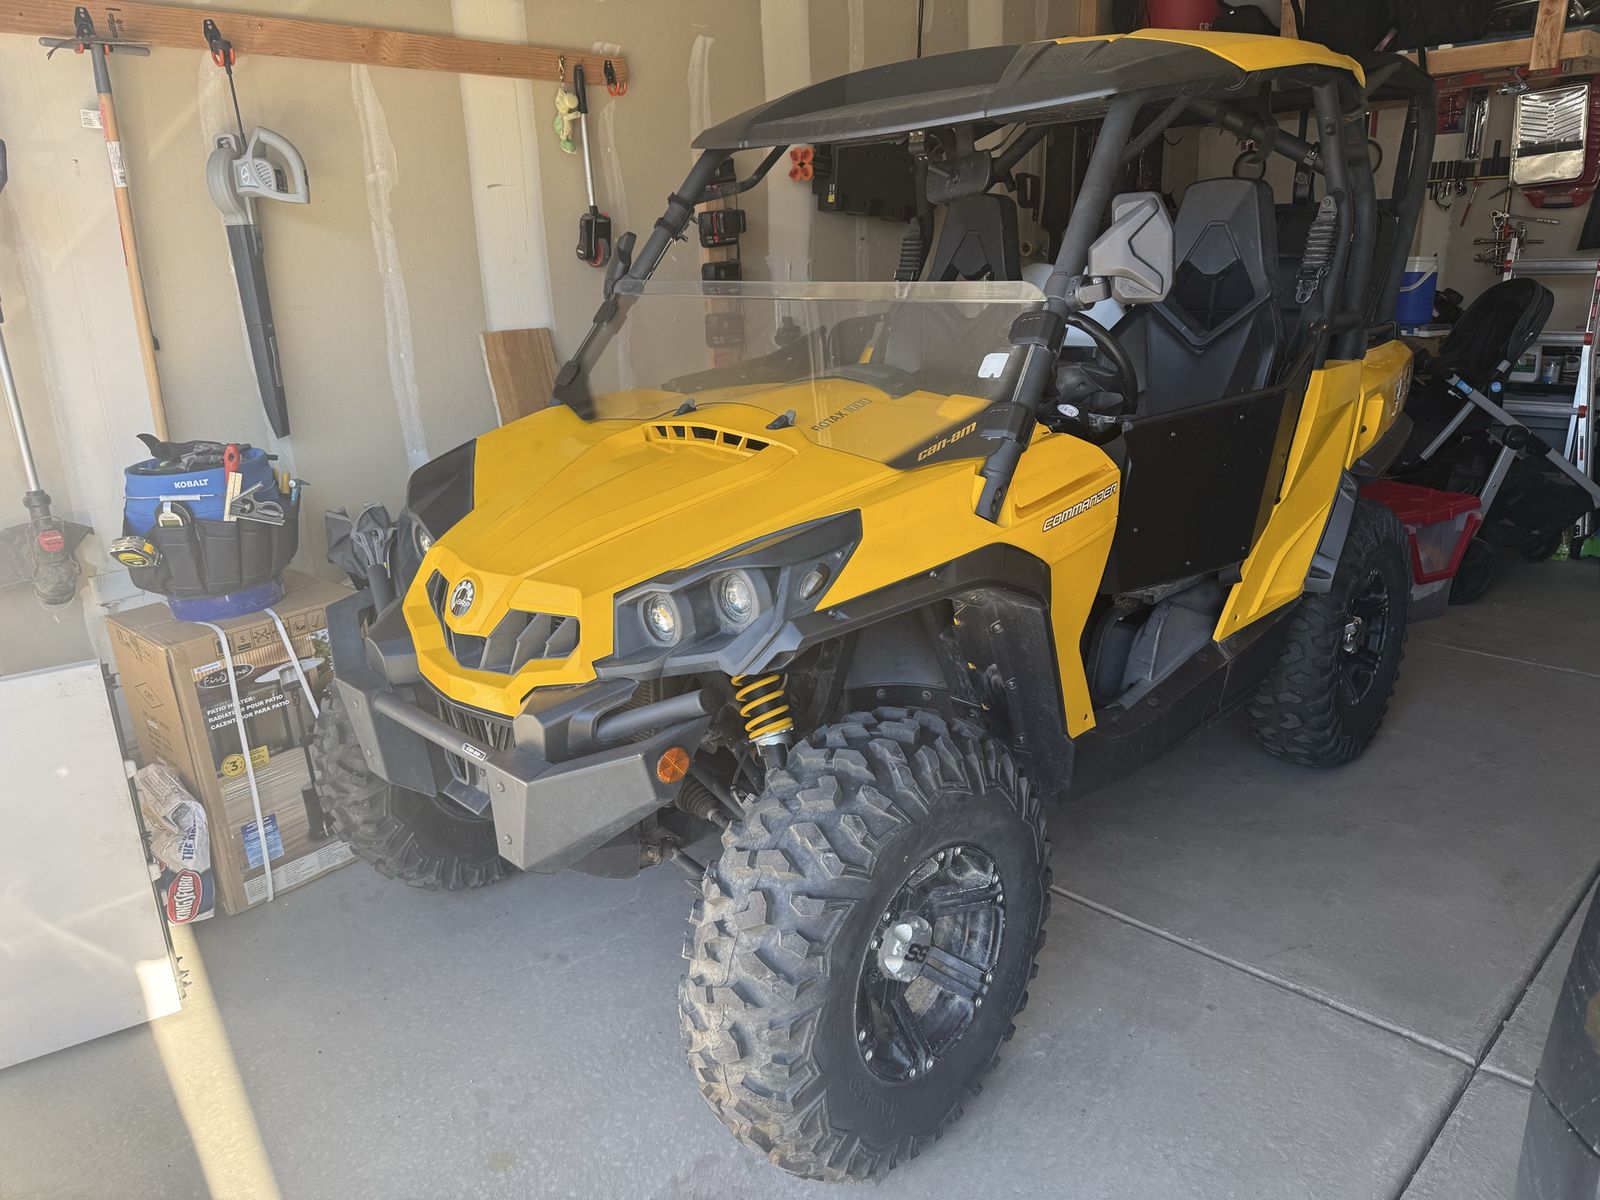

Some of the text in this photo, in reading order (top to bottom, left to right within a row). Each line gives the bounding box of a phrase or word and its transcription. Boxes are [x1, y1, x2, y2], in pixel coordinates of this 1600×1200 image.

[811, 397, 873, 431] ROTAX 1000
[917, 421, 977, 462] can-am
[174, 479, 208, 489] KOBALT
[1042, 481, 1118, 532] COMMANDER
[457, 599, 470, 608] BRP
[207, 705, 227, 716] PATIO
[246, 701, 264, 711] POUR
[265, 694, 283, 704] PATIO
[255, 706, 271, 716] PARA
[272, 700, 290, 710] PATIO
[230, 760, 239, 772] 3
[182, 844, 194, 861] THE
[174, 875, 196, 921] KINGSFORD
